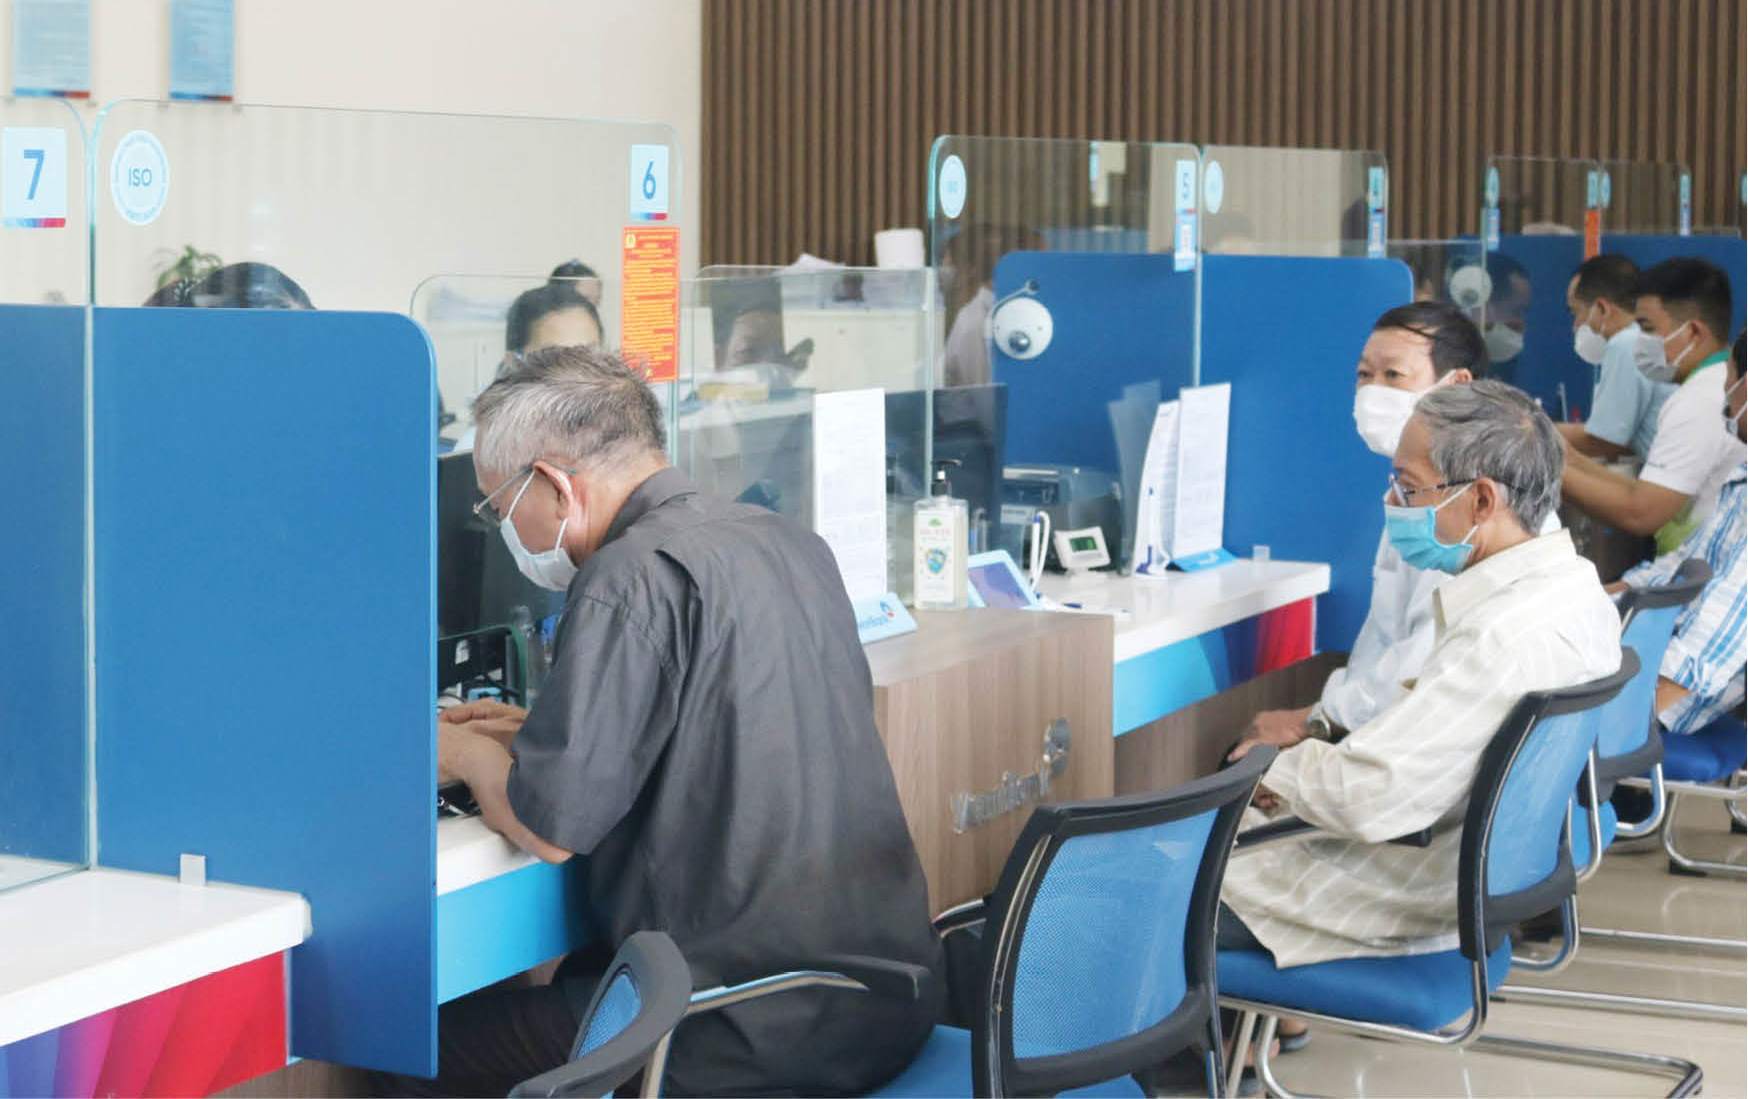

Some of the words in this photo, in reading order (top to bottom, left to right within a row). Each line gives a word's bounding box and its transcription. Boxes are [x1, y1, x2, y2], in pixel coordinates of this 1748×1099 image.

[23, 149, 45, 201] 7
[128, 168, 153, 188] ISO
[642, 160, 657, 200] 6
